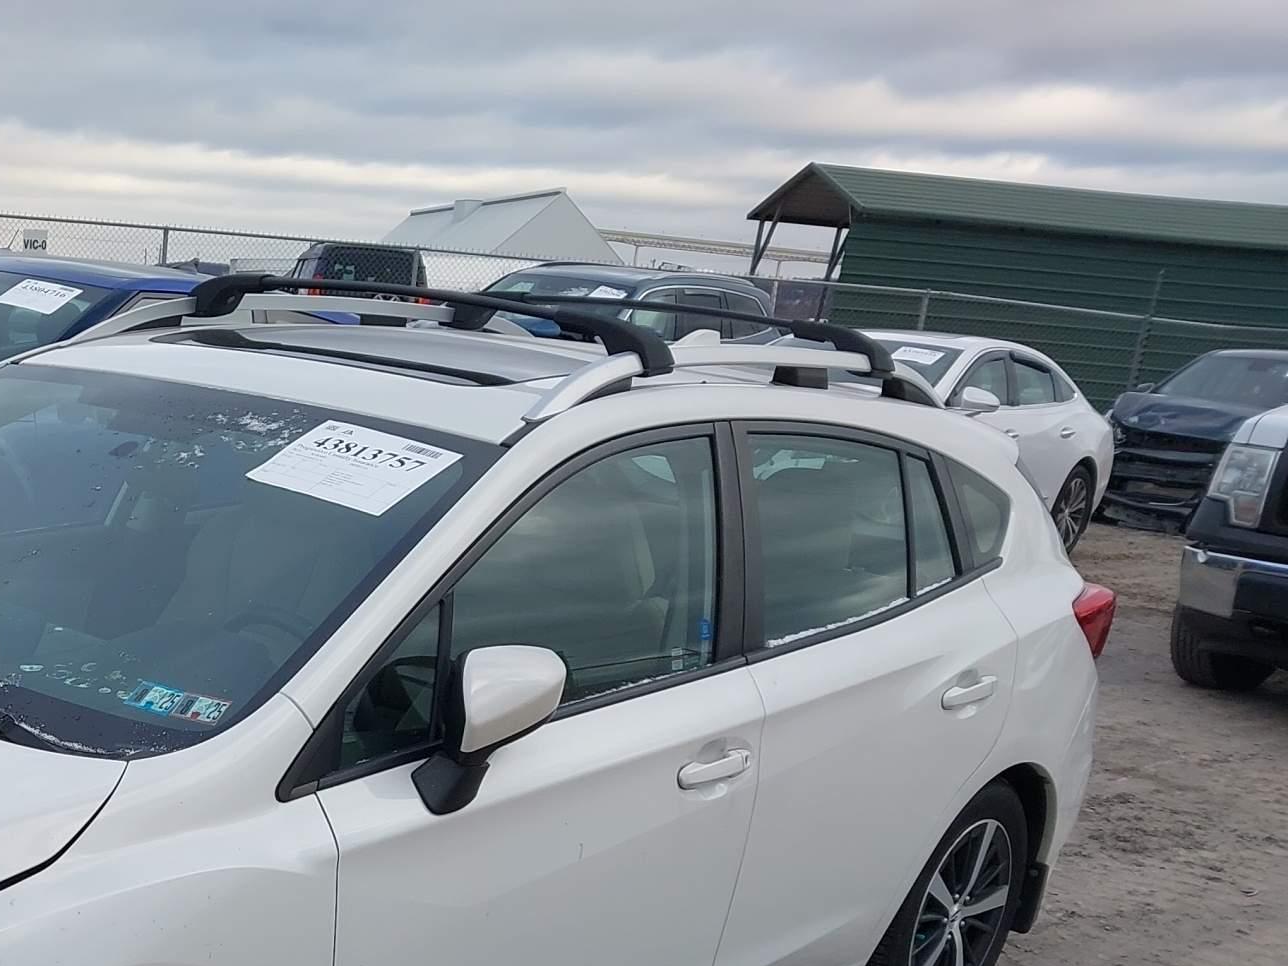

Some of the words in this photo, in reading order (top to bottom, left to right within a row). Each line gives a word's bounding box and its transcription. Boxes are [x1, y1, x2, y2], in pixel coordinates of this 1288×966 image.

[313, 436, 427, 472] 43813757
[159, 693, 181, 711] 25
[206, 702, 228, 720] 25
